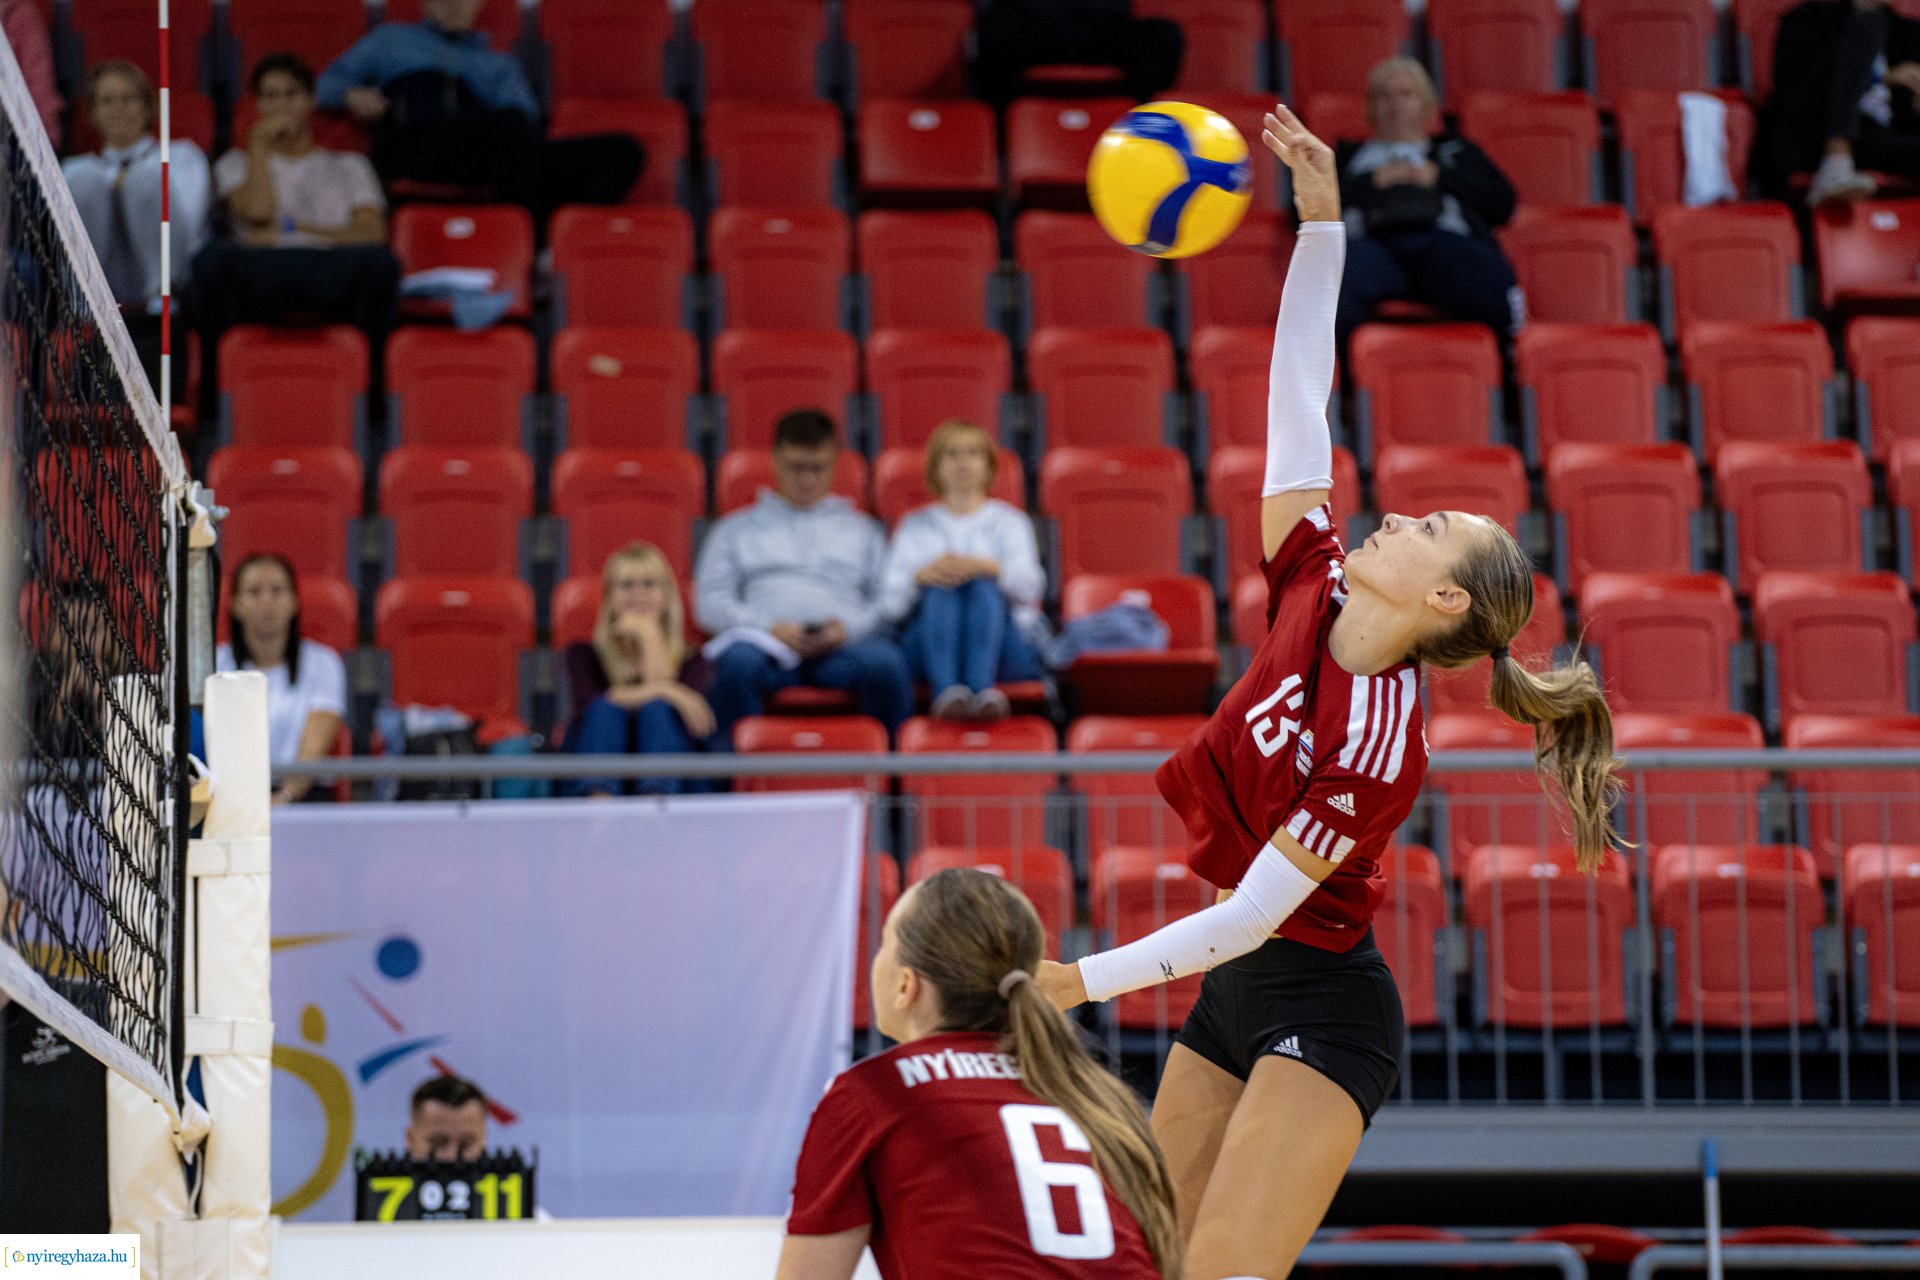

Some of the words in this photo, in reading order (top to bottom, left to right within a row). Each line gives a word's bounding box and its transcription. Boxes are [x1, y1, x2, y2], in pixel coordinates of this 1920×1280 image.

[1245, 673, 1305, 758] 13
[1327, 796, 1357, 817] adidas
[369, 1176, 414, 1223] 7
[474, 1172, 523, 1221] 11
[1000, 1103, 1115, 1260] 6
